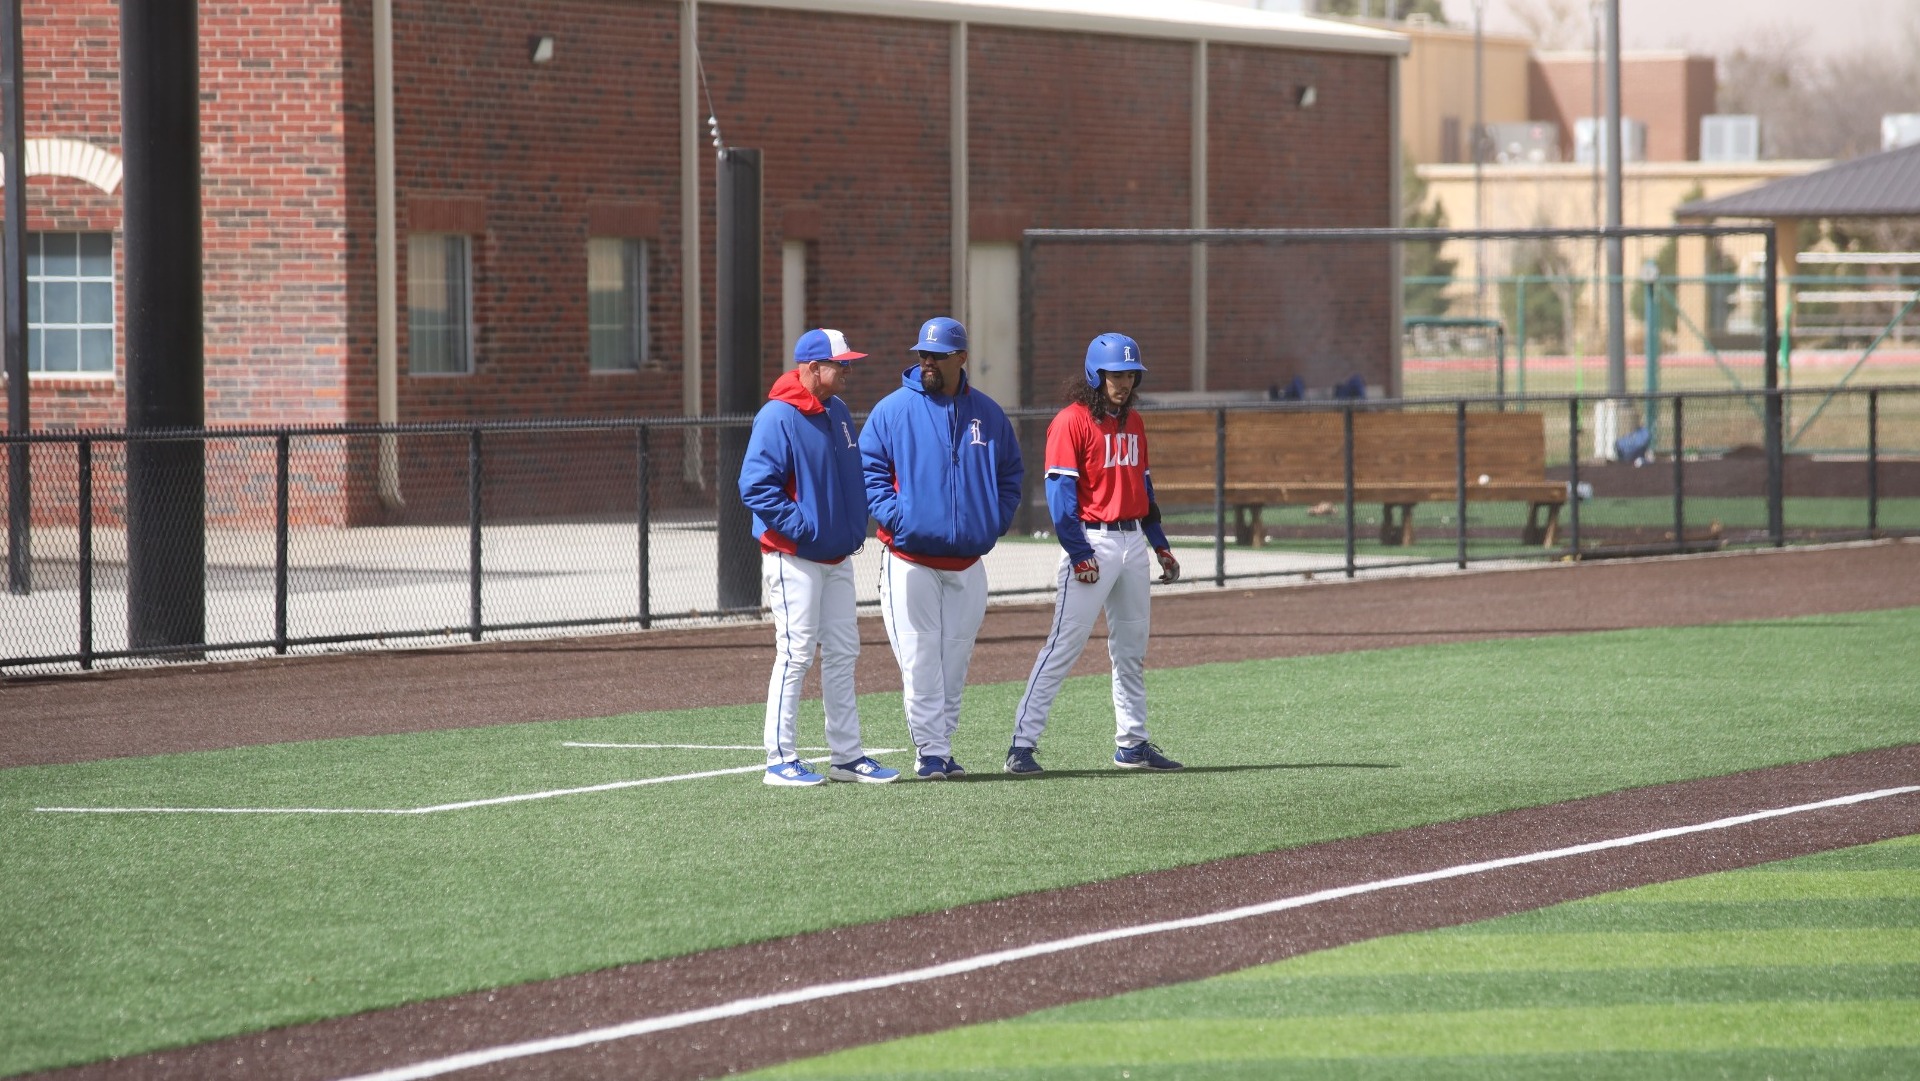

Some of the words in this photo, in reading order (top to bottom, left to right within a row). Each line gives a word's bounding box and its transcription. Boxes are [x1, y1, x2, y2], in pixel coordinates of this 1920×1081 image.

[1123, 346, 1136, 362] L
[970, 418, 987, 447] L
[1103, 432, 1139, 469] LCU
